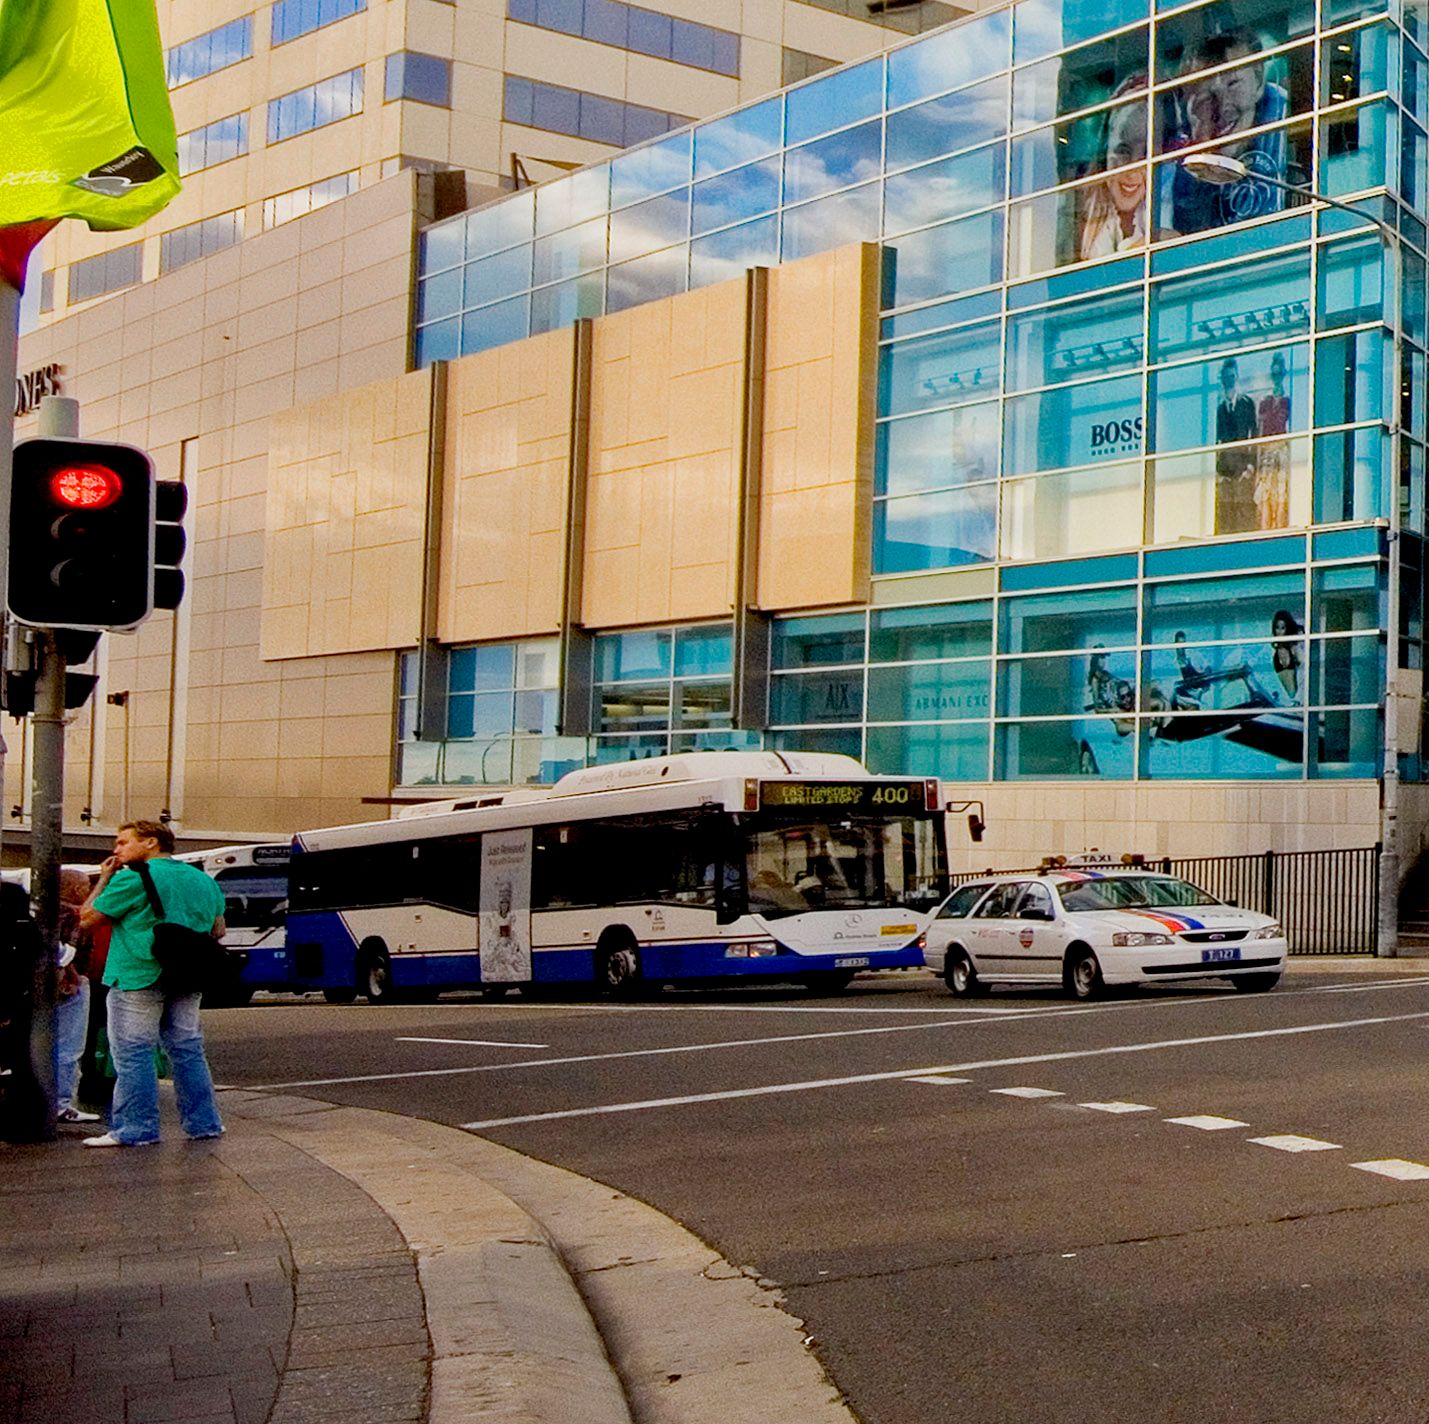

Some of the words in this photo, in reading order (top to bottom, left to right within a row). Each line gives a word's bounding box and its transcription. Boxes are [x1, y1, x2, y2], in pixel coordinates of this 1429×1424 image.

[782, 785, 864, 796] EASTGARDENS
[872, 786, 908, 804] 400
[1081, 855, 1112, 863] TAXI
